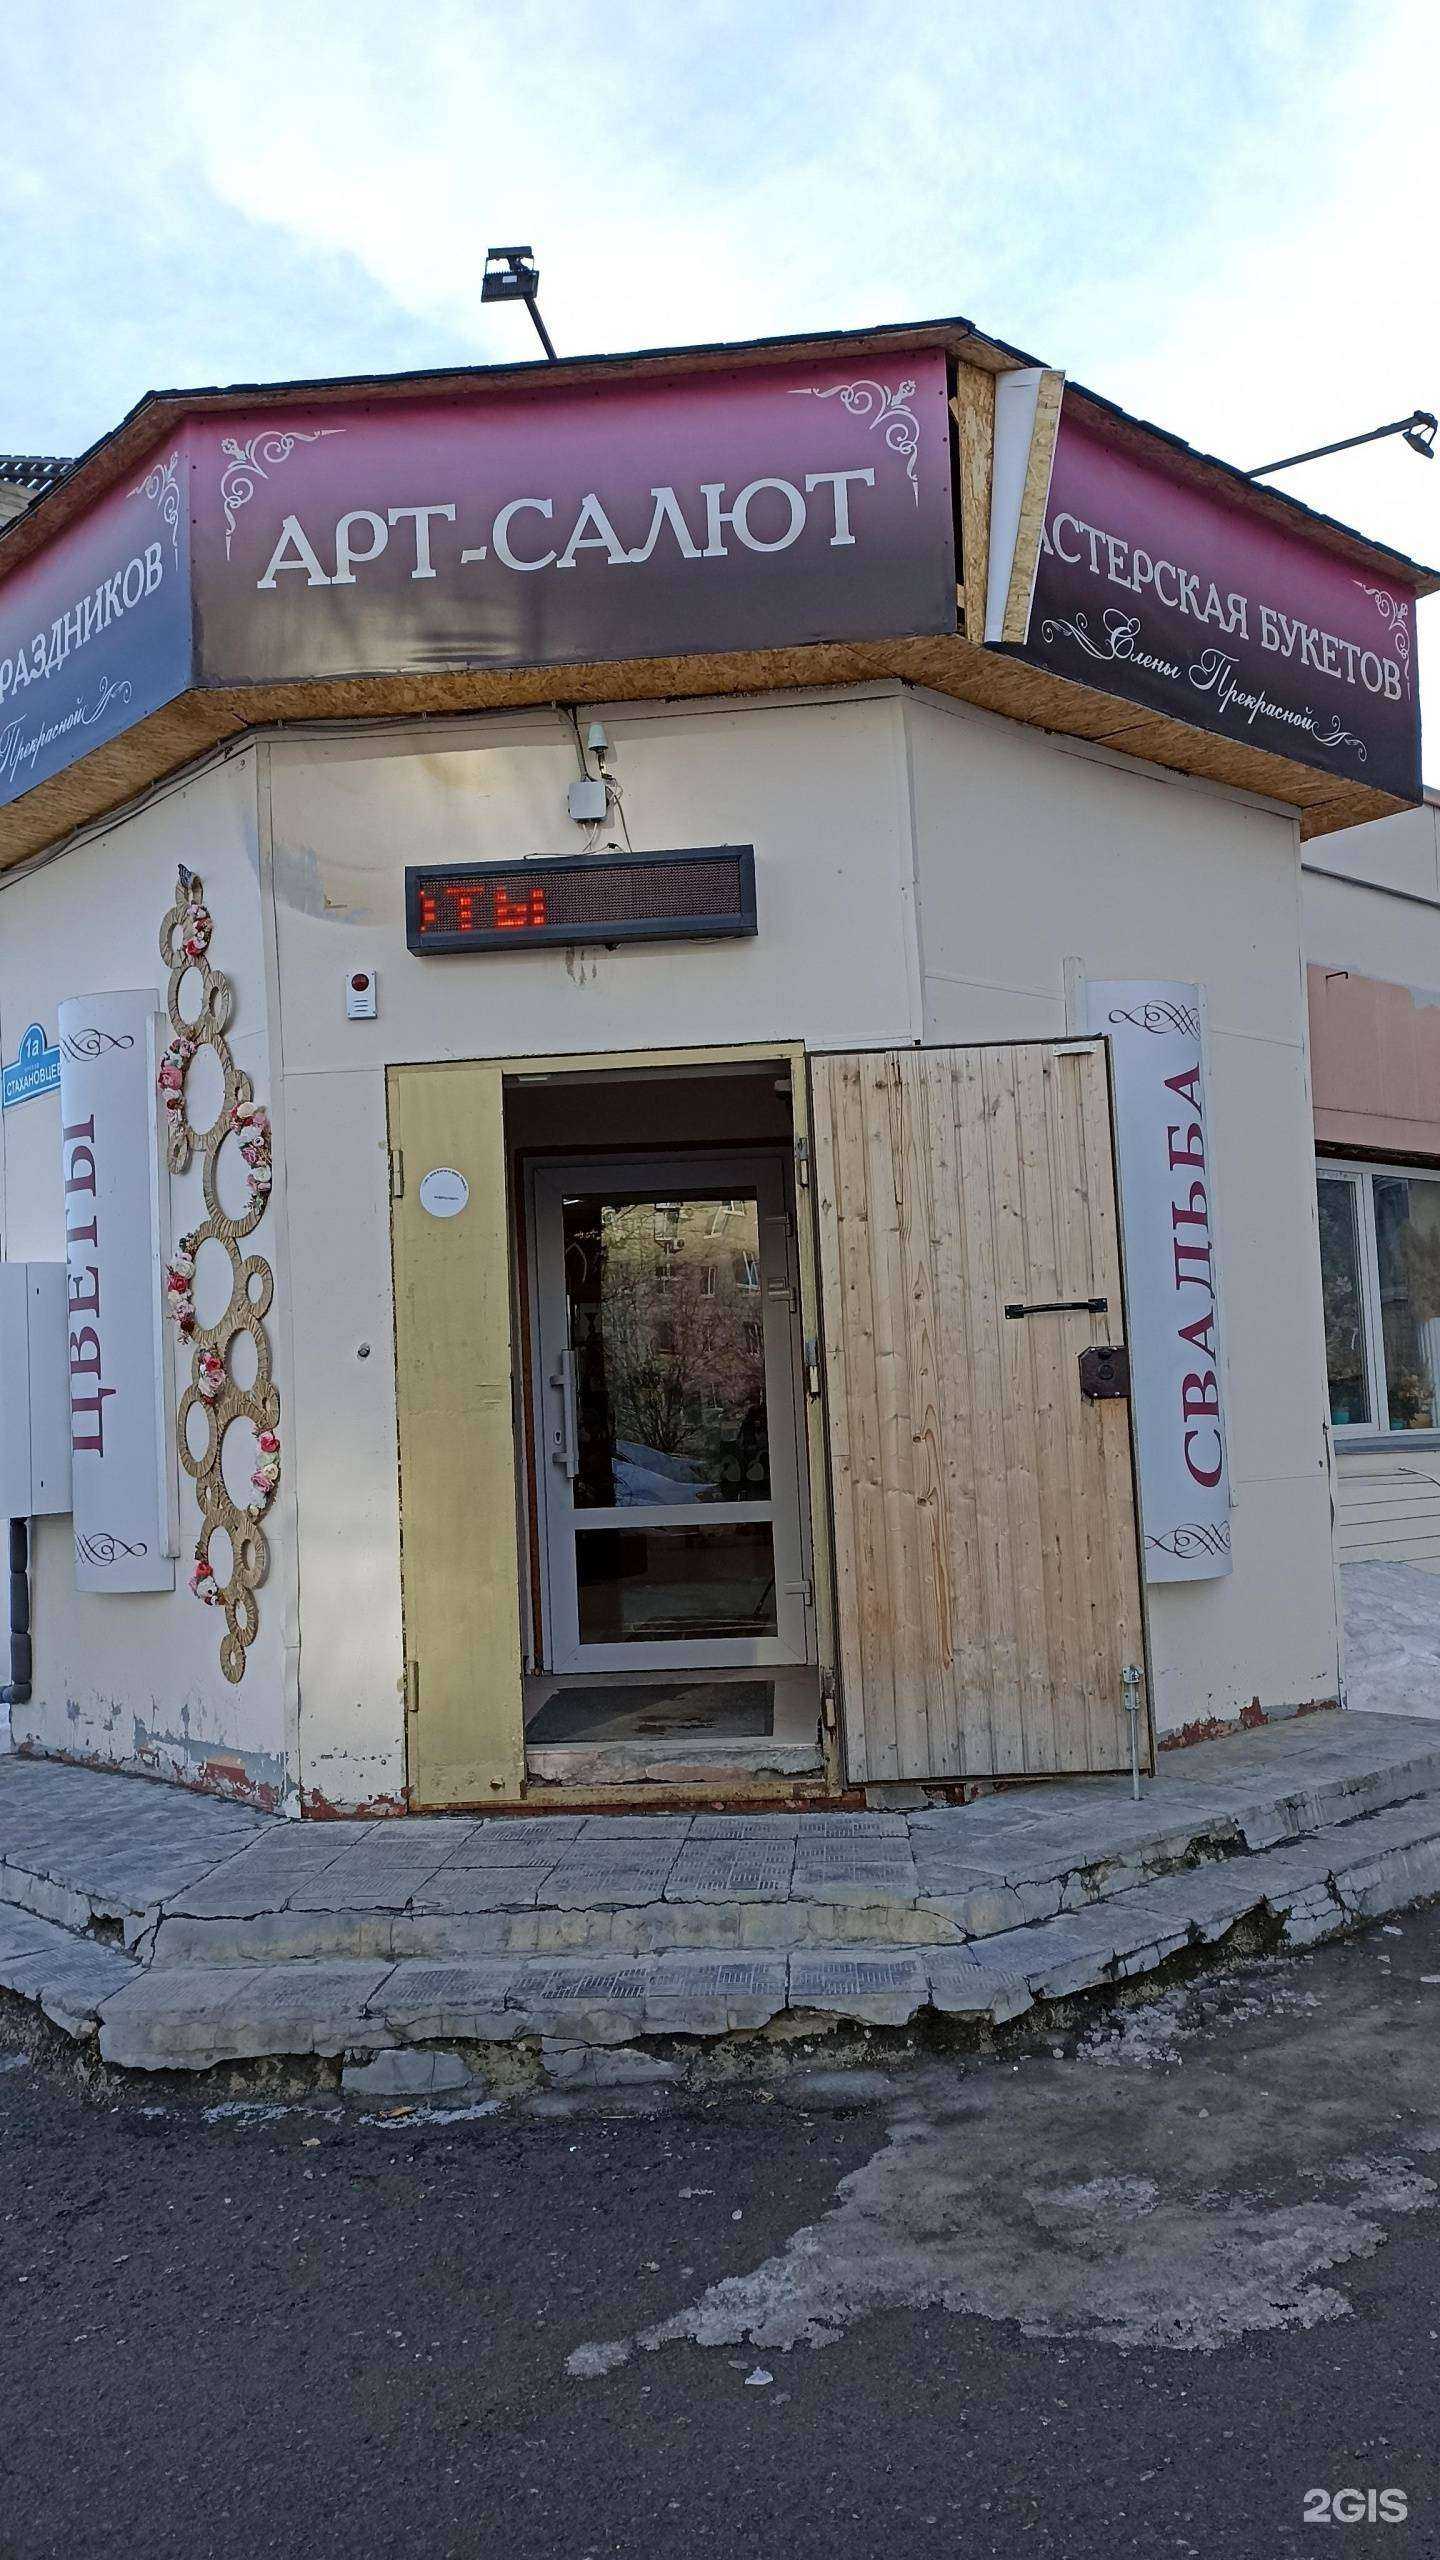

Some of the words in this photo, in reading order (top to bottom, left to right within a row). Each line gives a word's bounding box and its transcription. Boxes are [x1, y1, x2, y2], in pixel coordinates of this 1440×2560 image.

[256, 467, 876, 589] АРТ-САЛЮТ
[0, 541, 163, 704] РАЗДНИКОВ
[1102, 608, 1182, 680] Елены
[1188, 648, 1313, 731] Прекрасной
[1259, 604, 1402, 700] БУКЕТОВ
[63, 1113, 117, 1458] ЦВЕТЫ
[1164, 1061, 1223, 1488] СВАДЬБА
